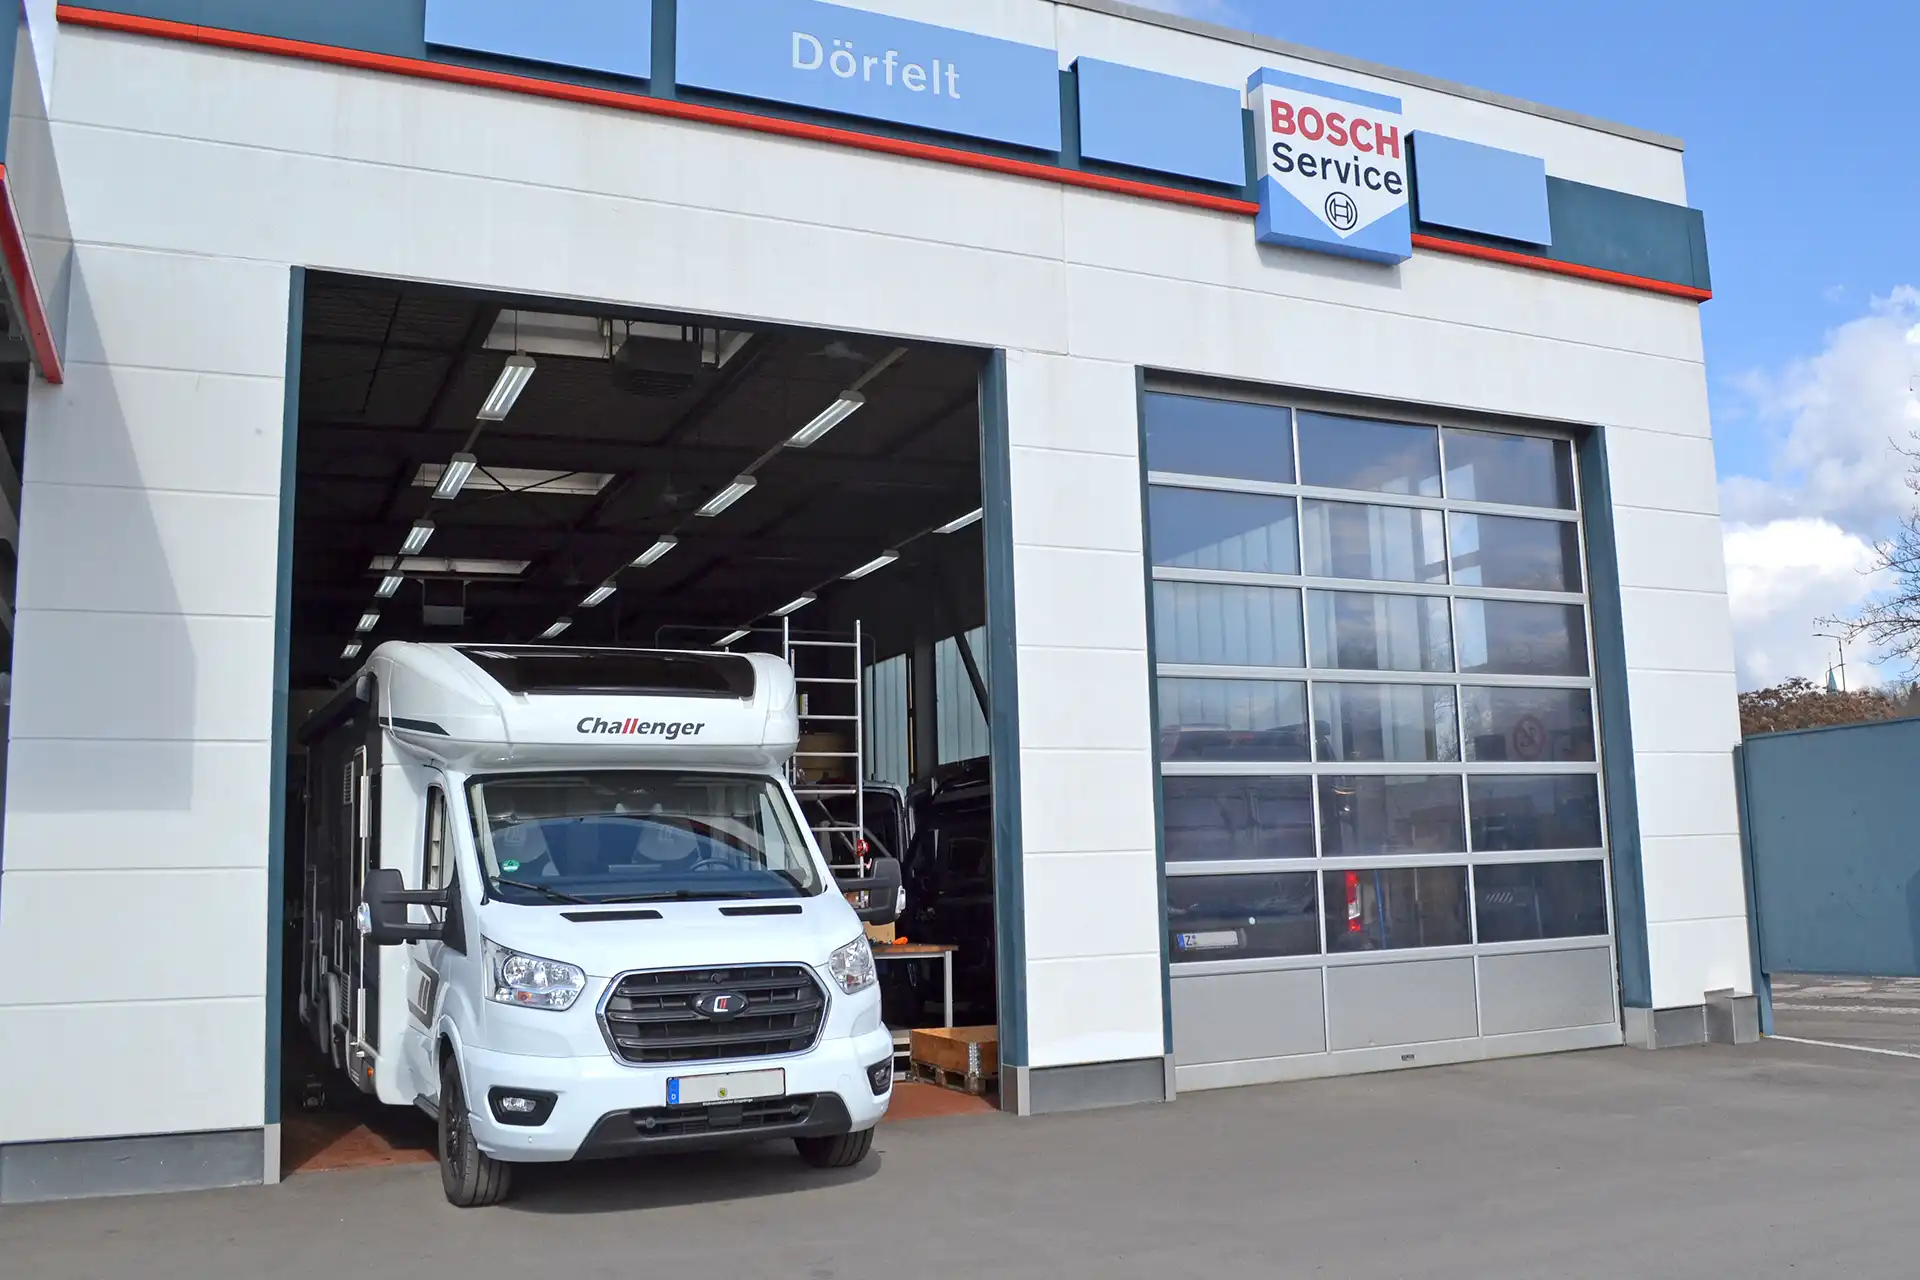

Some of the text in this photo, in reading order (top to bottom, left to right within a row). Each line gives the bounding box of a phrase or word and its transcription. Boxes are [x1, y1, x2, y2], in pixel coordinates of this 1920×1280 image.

[792, 31, 961, 99] Dörfelt
[1270, 99, 1400, 159] BOSCH
[1272, 142, 1403, 195] Service
[576, 717, 705, 740] Challenger
[1184, 935, 1193, 946] Z
